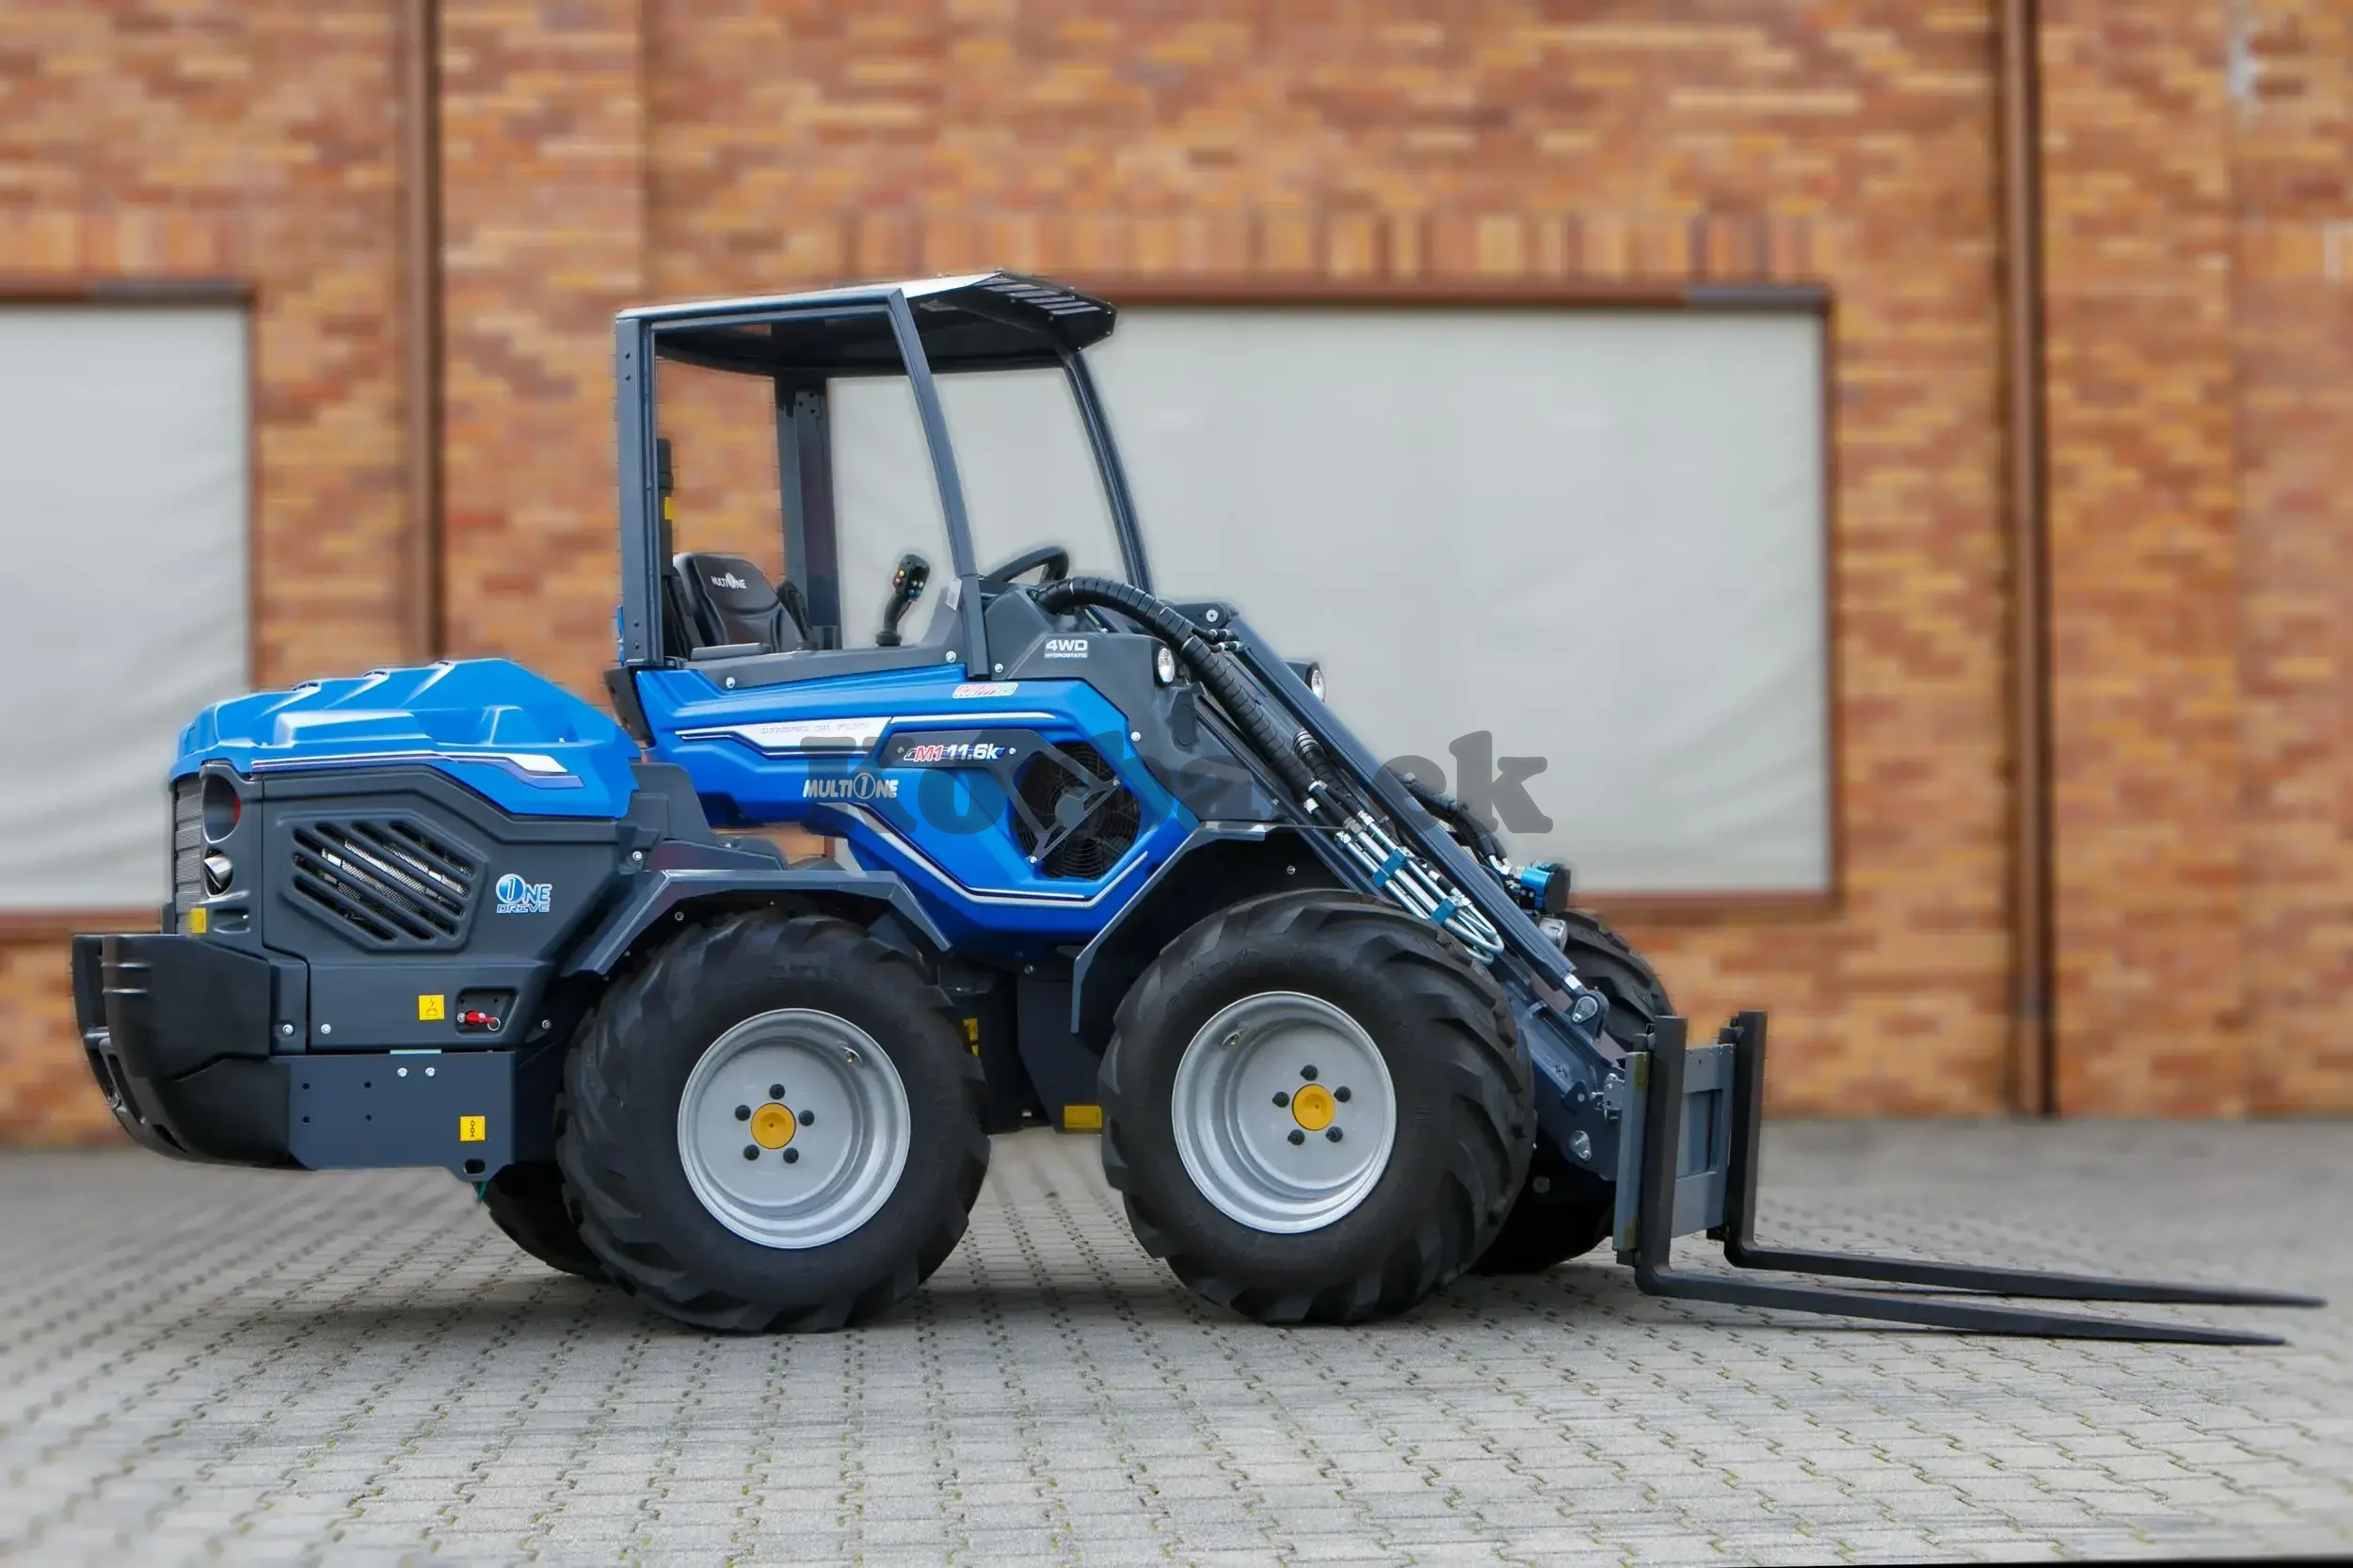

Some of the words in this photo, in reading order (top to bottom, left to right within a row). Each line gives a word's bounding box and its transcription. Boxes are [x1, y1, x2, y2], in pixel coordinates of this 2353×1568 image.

[1046, 639, 1088, 651] 4WD
[913, 744, 944, 762] M1
[946, 743, 999, 760] 11.6k
[496, 904, 551, 913] DRIVE
